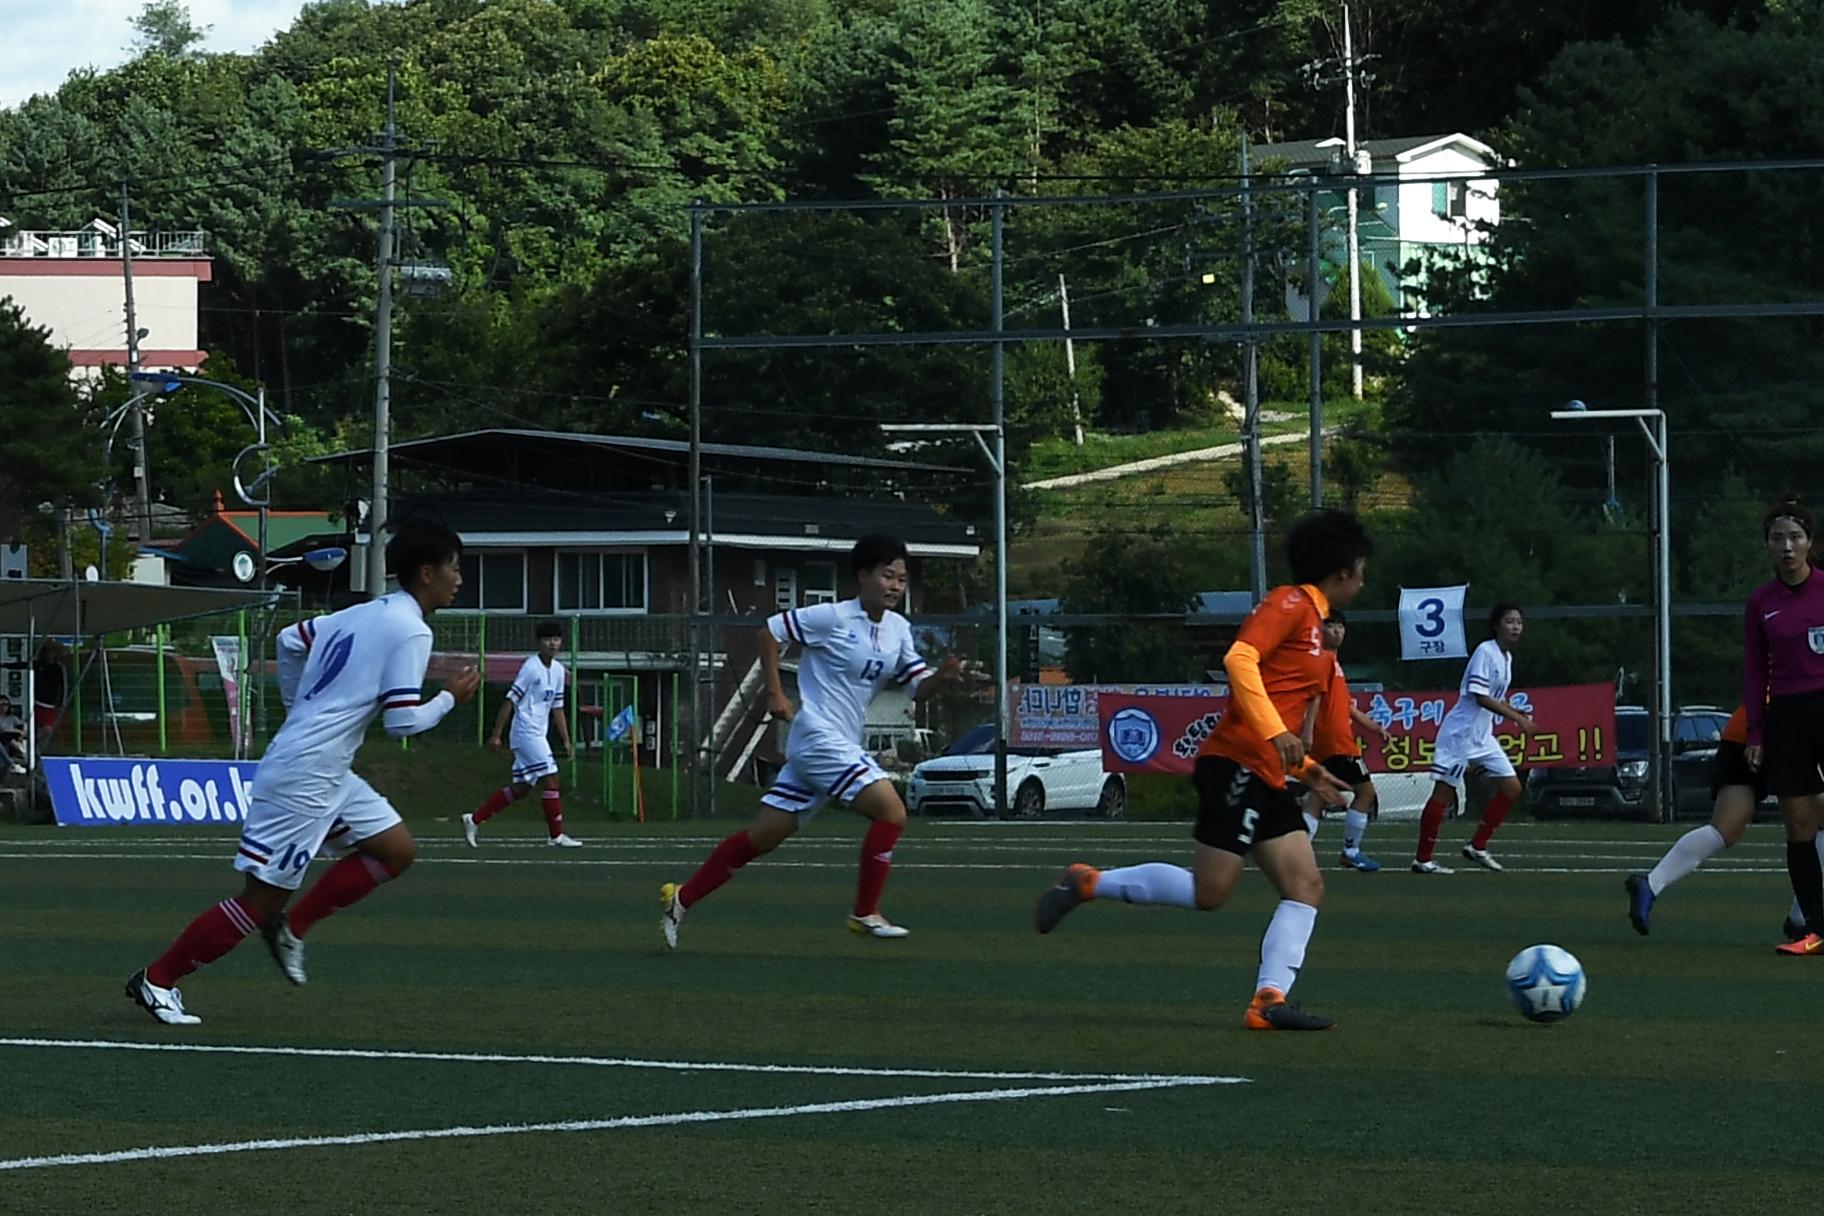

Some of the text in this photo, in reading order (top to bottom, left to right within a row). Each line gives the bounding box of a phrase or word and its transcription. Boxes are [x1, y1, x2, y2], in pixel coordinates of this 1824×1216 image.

[1415, 598, 1445, 637] 3
[1420, 640, 1445, 653] 구장
[860, 659, 883, 681] 13
[1381, 732, 1565, 771] 정보업고
[1579, 726, 1603, 761] !!
[1236, 807, 1261, 845] 5
[279, 843, 310, 875] 19
